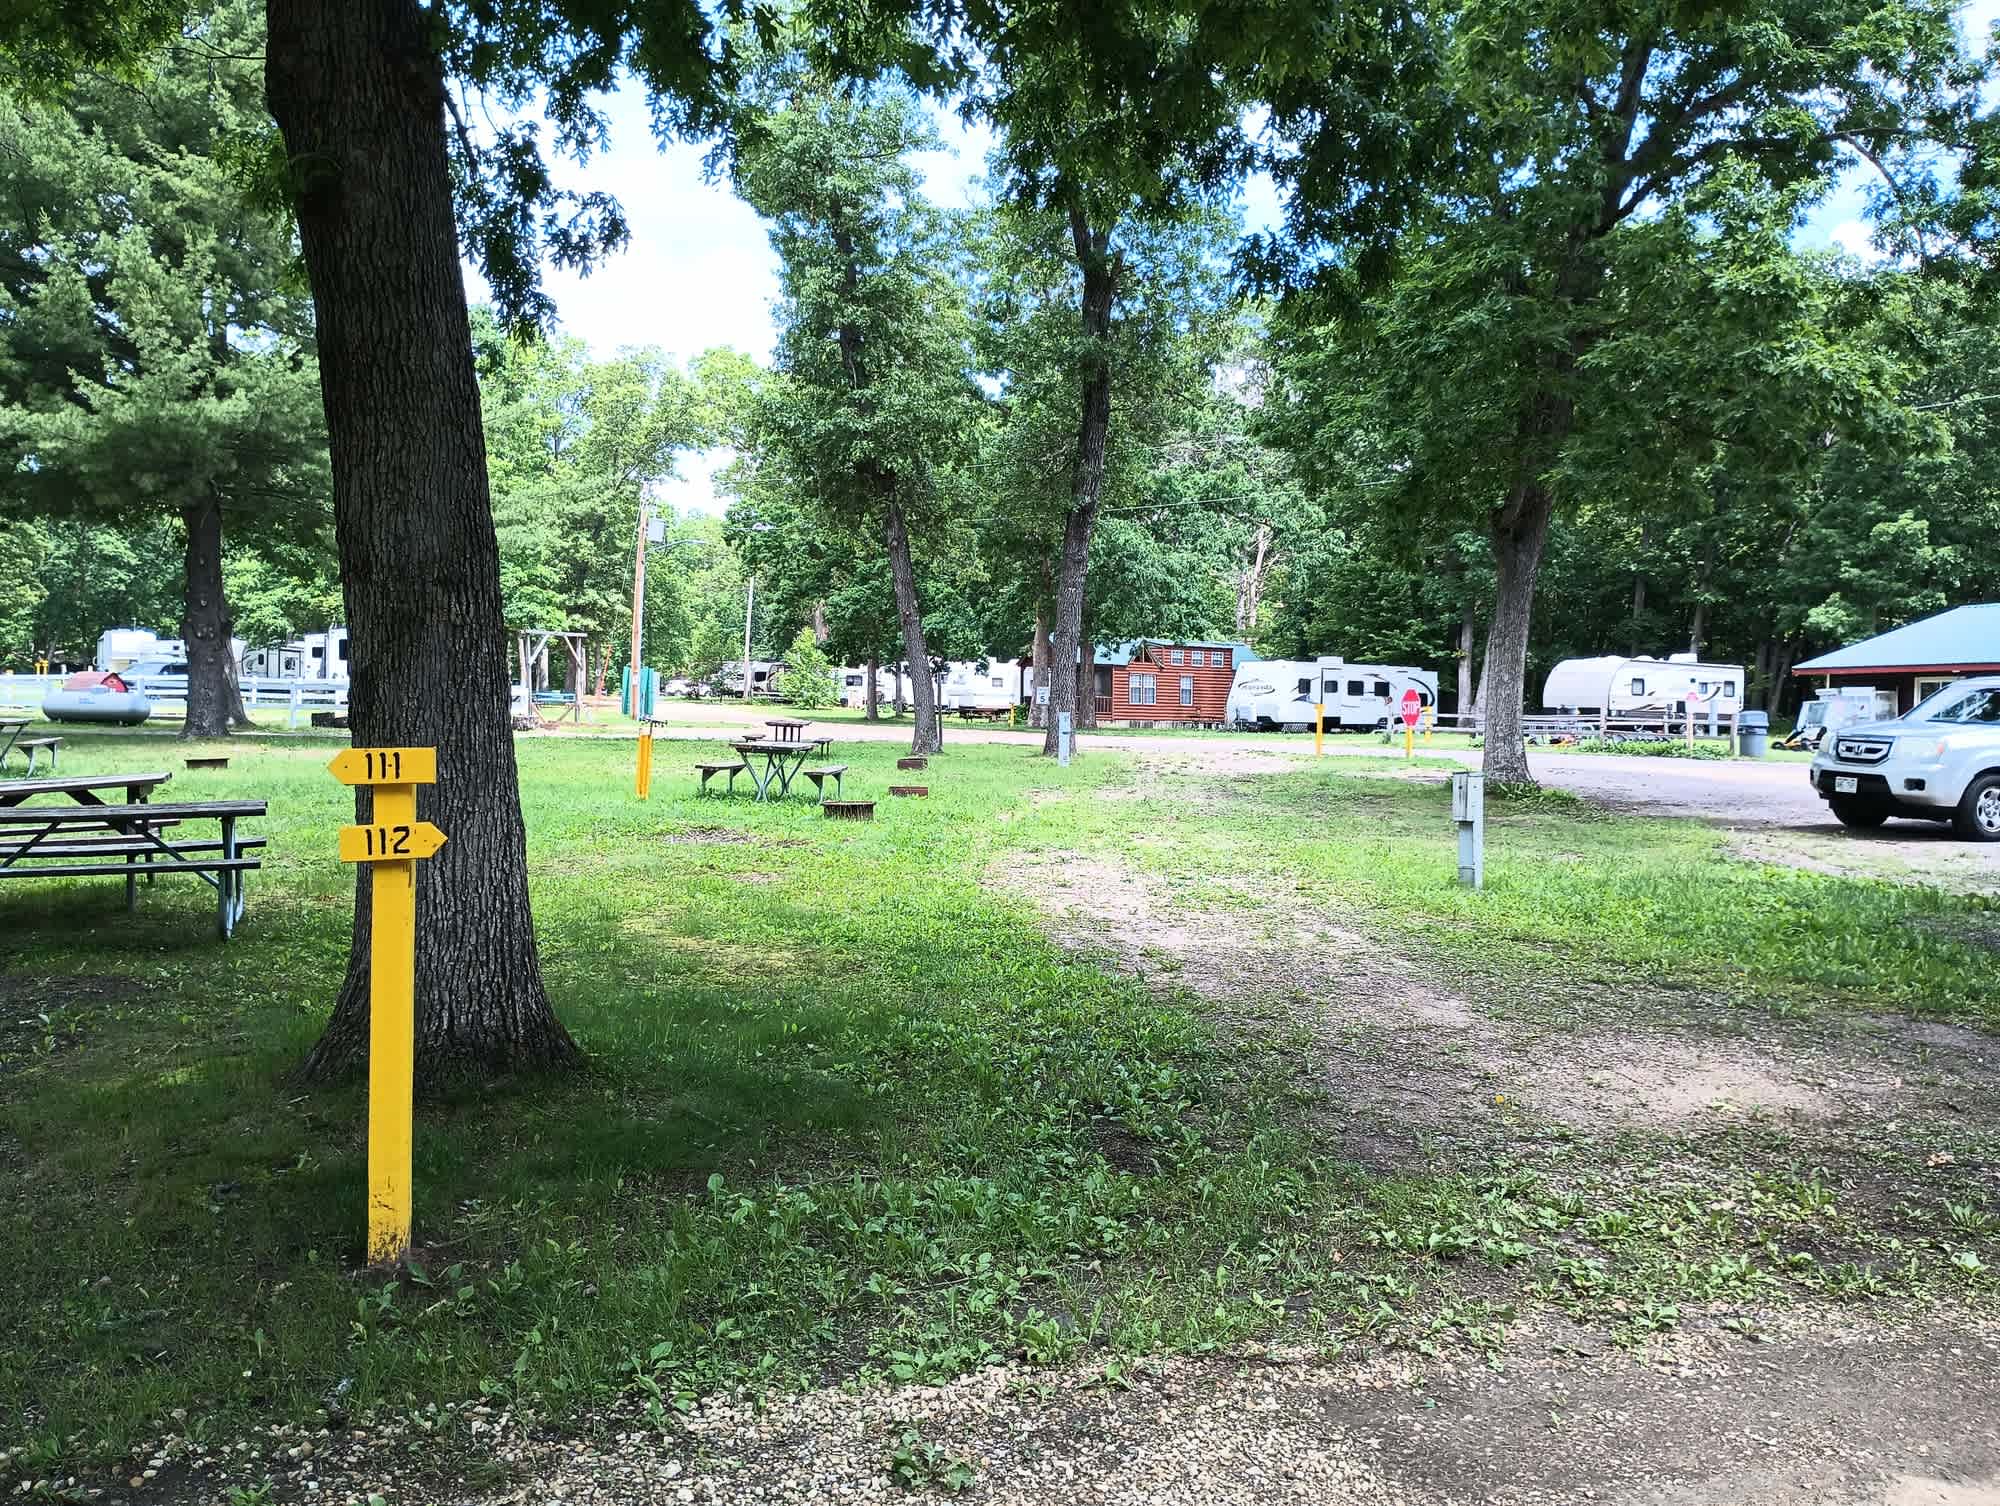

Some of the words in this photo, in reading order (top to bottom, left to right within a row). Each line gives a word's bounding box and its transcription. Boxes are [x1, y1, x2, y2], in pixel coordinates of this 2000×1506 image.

[1402, 701, 1419, 714] STOP
[365, 752, 400, 780] 111
[365, 826, 410, 856] 112
